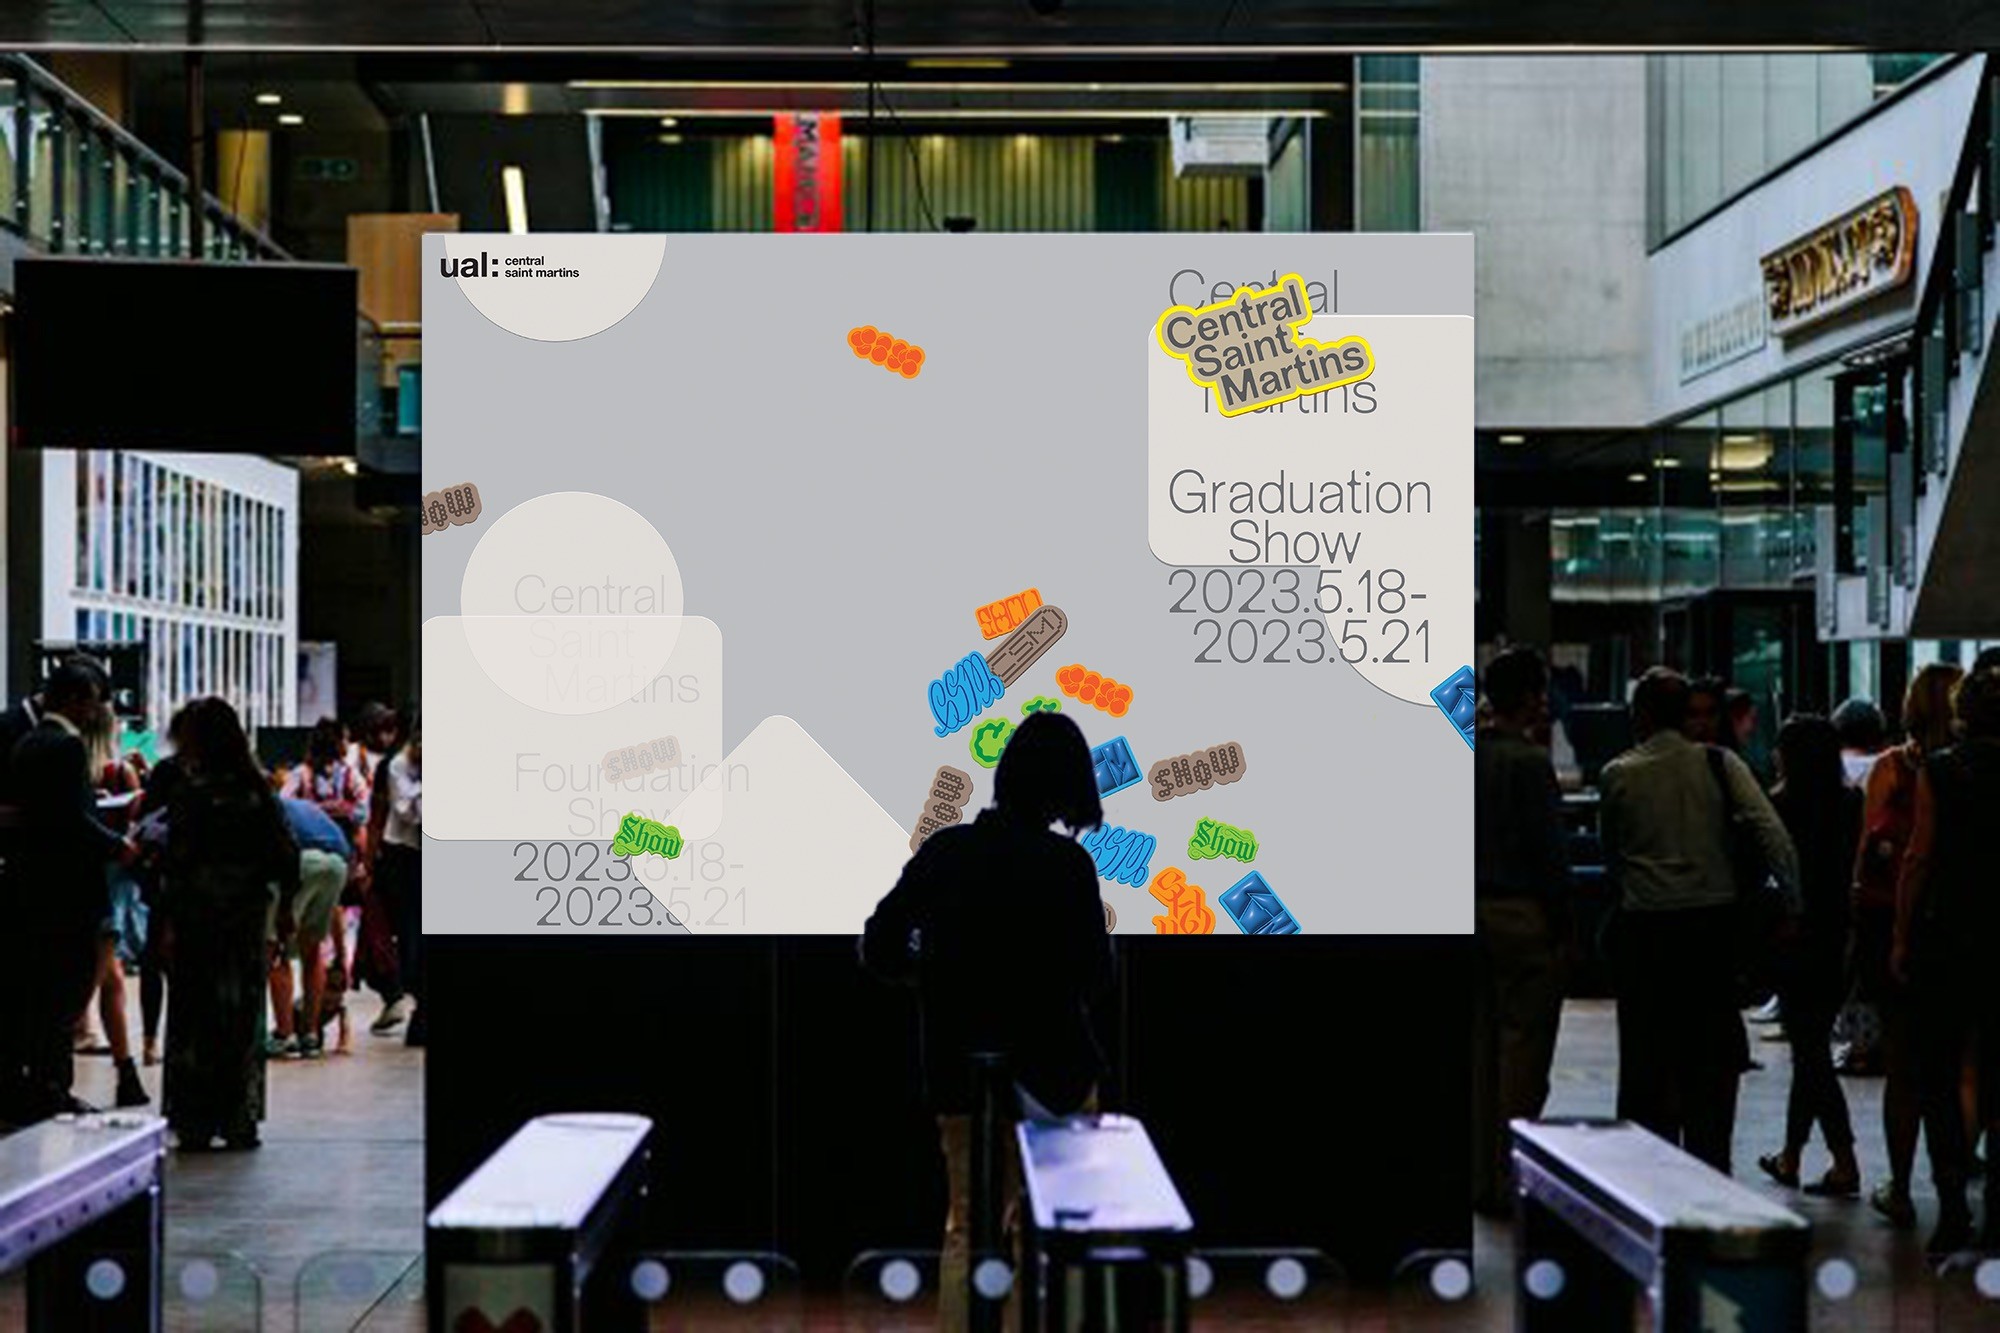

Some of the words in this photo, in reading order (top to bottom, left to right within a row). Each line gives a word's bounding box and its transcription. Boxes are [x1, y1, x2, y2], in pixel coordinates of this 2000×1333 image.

[440, 252, 499, 278] ual:
[505, 256, 545, 266] central
[505, 267, 533, 278] saint
[536, 267, 580, 278] martins
[1167, 285, 1302, 349] Central
[1194, 324, 1294, 377] Saint
[1220, 346, 1366, 406] Martins
[1169, 469, 1431, 514] Graduation
[1229, 519, 1361, 564] Show
[514, 574, 665, 614] Central
[1168, 569, 1427, 614] 2023.5.18-
[529, 620, 635, 659] Saint
[1193, 619, 1429, 664] 2023.5.21
[545, 664, 700, 703] Martins
[616, 816, 682, 858] Show
[1190, 819, 1258, 862] Show
[536, 886, 747, 927] 2023.5.21
